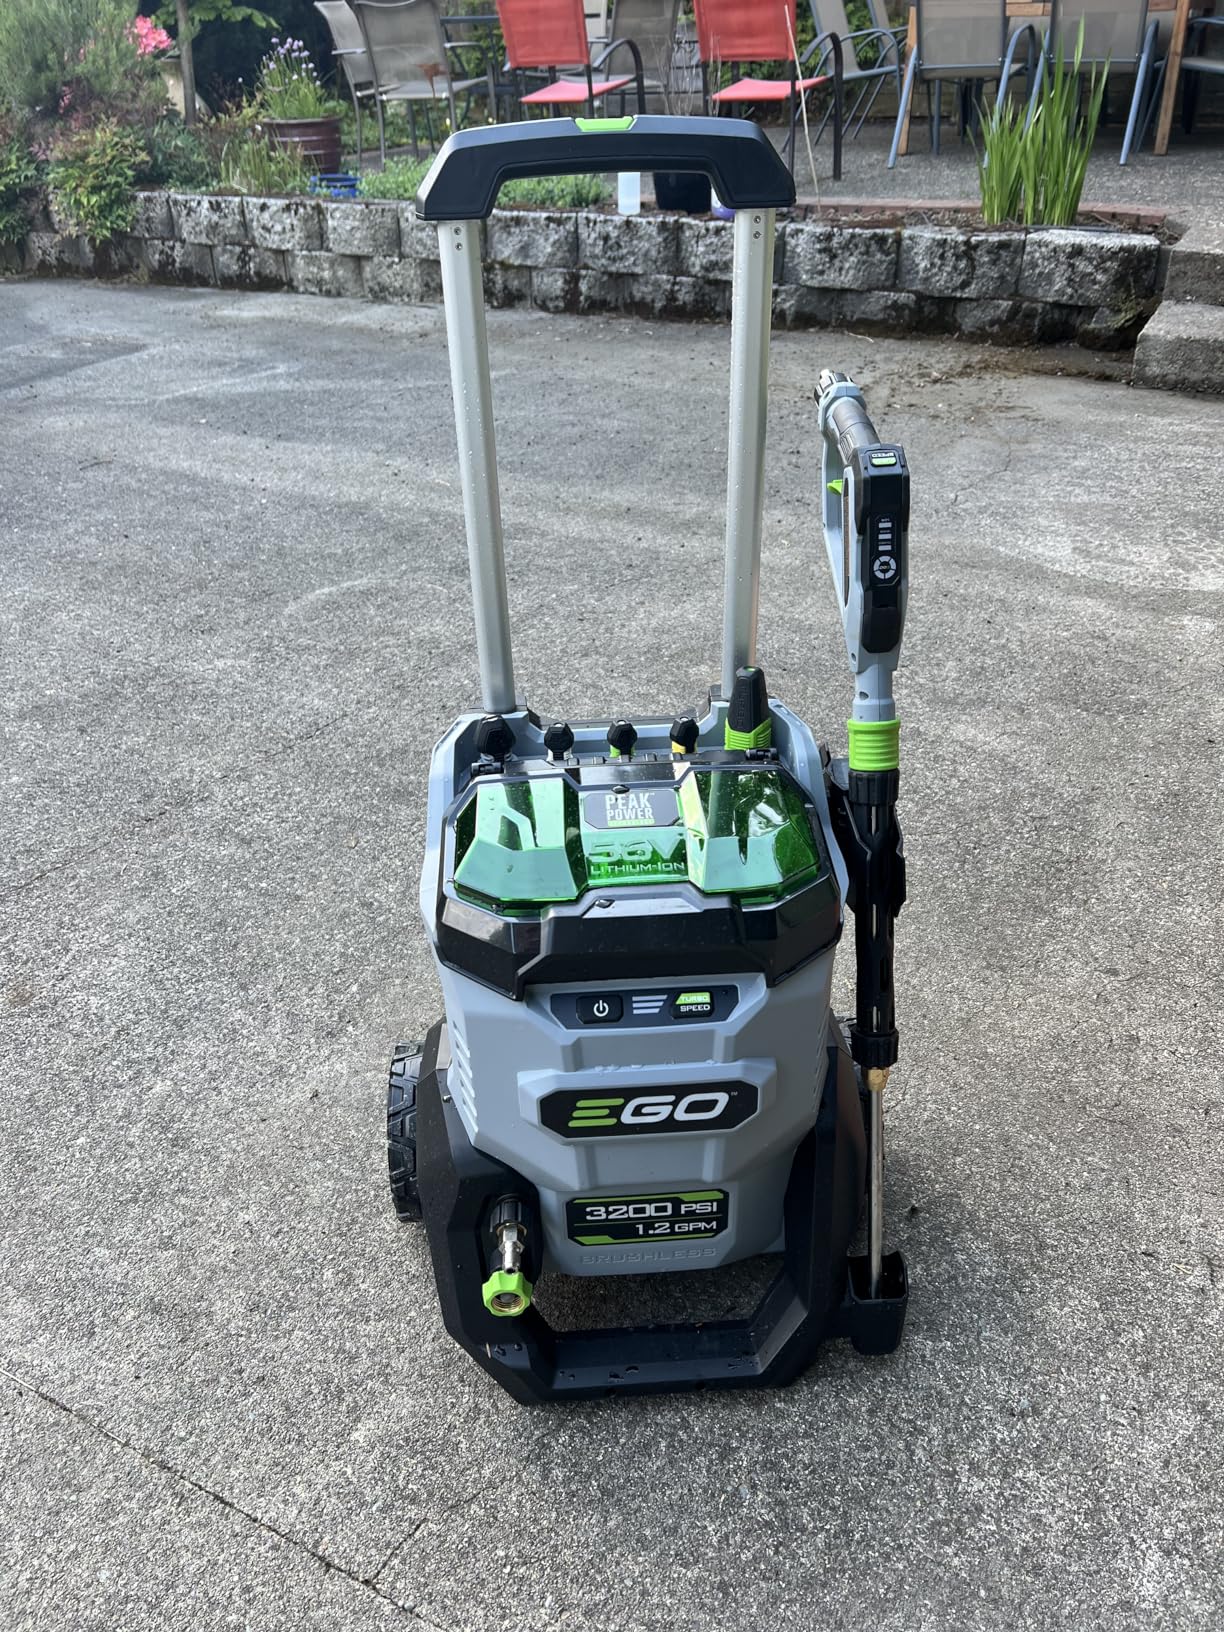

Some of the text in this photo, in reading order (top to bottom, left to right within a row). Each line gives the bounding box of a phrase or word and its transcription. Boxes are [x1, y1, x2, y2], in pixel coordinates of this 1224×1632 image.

[605, 793, 651, 810] PEAK
[607, 808, 653, 820] POWER
[589, 840, 681, 863] 56V
[591, 862, 685, 874] LITHIUM-ION
[680, 1004, 710, 1012] SPEED
[568, 1092, 730, 1127] EGO
[586, 1202, 718, 1220] 3200 PSI
[635, 1221, 717, 1235] 1.2 GPM
[582, 1248, 717, 1265] BRUSHLESS
